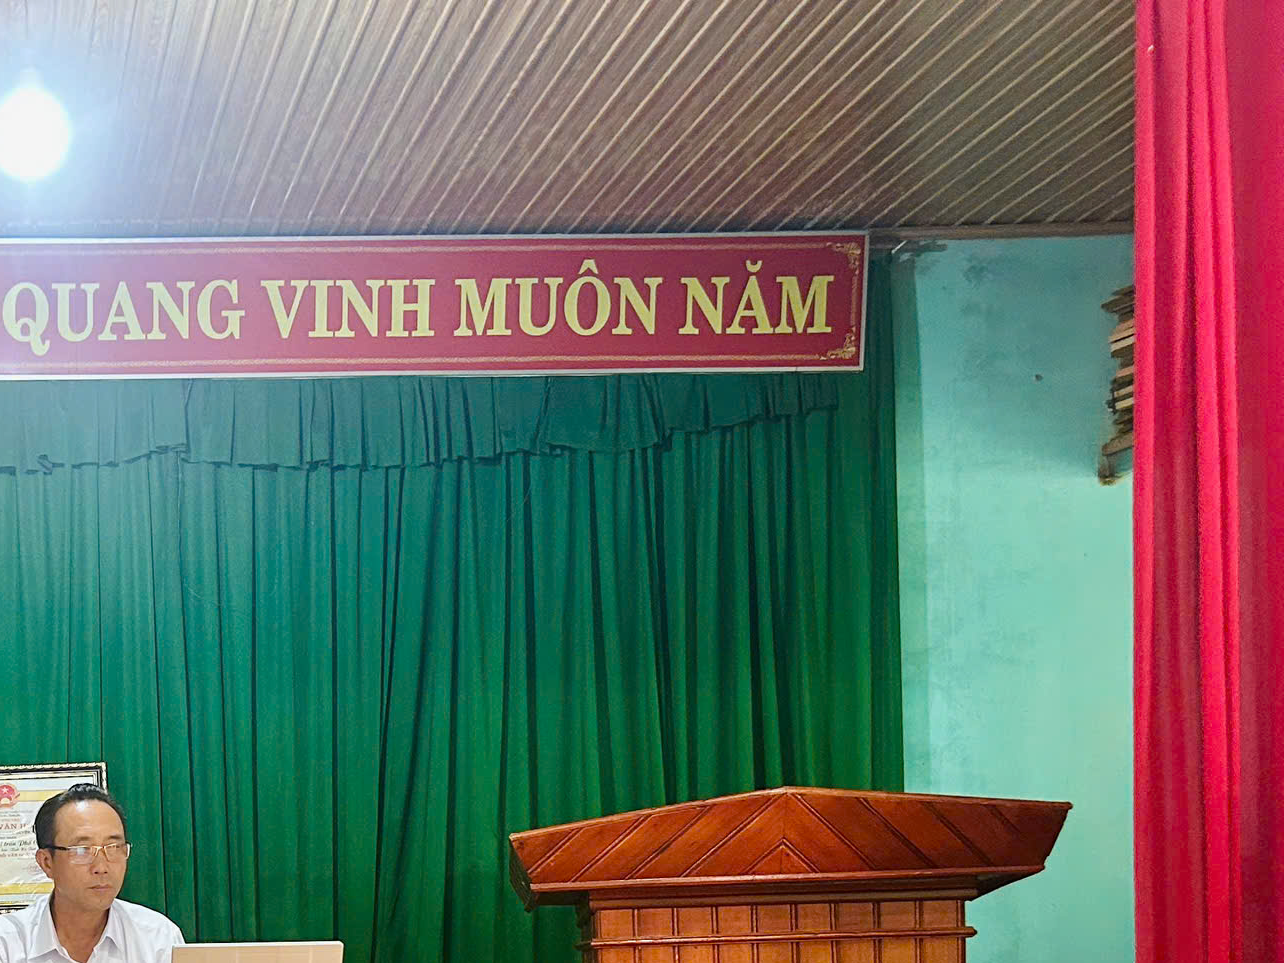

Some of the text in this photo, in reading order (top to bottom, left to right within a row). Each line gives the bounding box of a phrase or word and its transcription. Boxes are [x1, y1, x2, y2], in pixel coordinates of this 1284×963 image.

[2, 279, 245, 356] QUANG
[260, 278, 436, 338] VINH
[454, 259, 662, 336] MUÔN
[678, 260, 834, 335] NĂM
